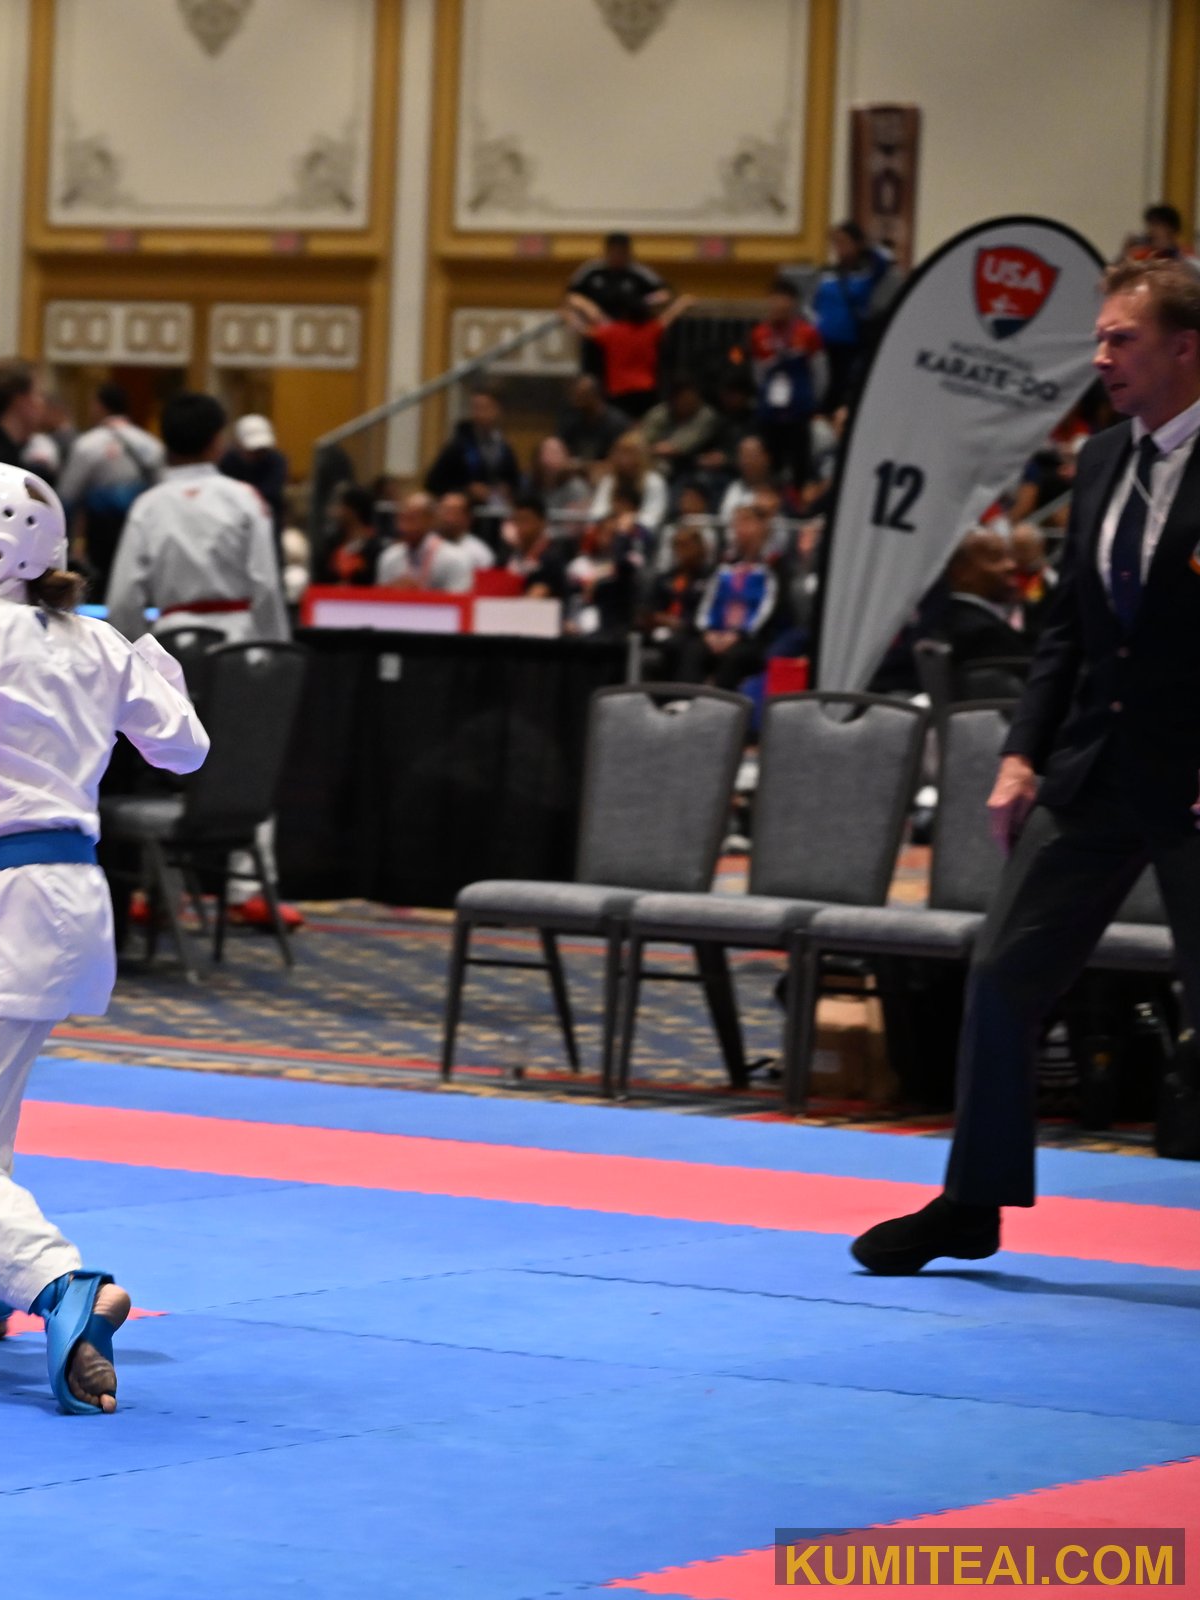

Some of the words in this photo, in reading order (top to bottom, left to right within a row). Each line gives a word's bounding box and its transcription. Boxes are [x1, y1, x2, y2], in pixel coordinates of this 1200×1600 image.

[982, 256, 1044, 293] USA
[915, 350, 1061, 402] KARATE-DO
[872, 460, 925, 534] 12
